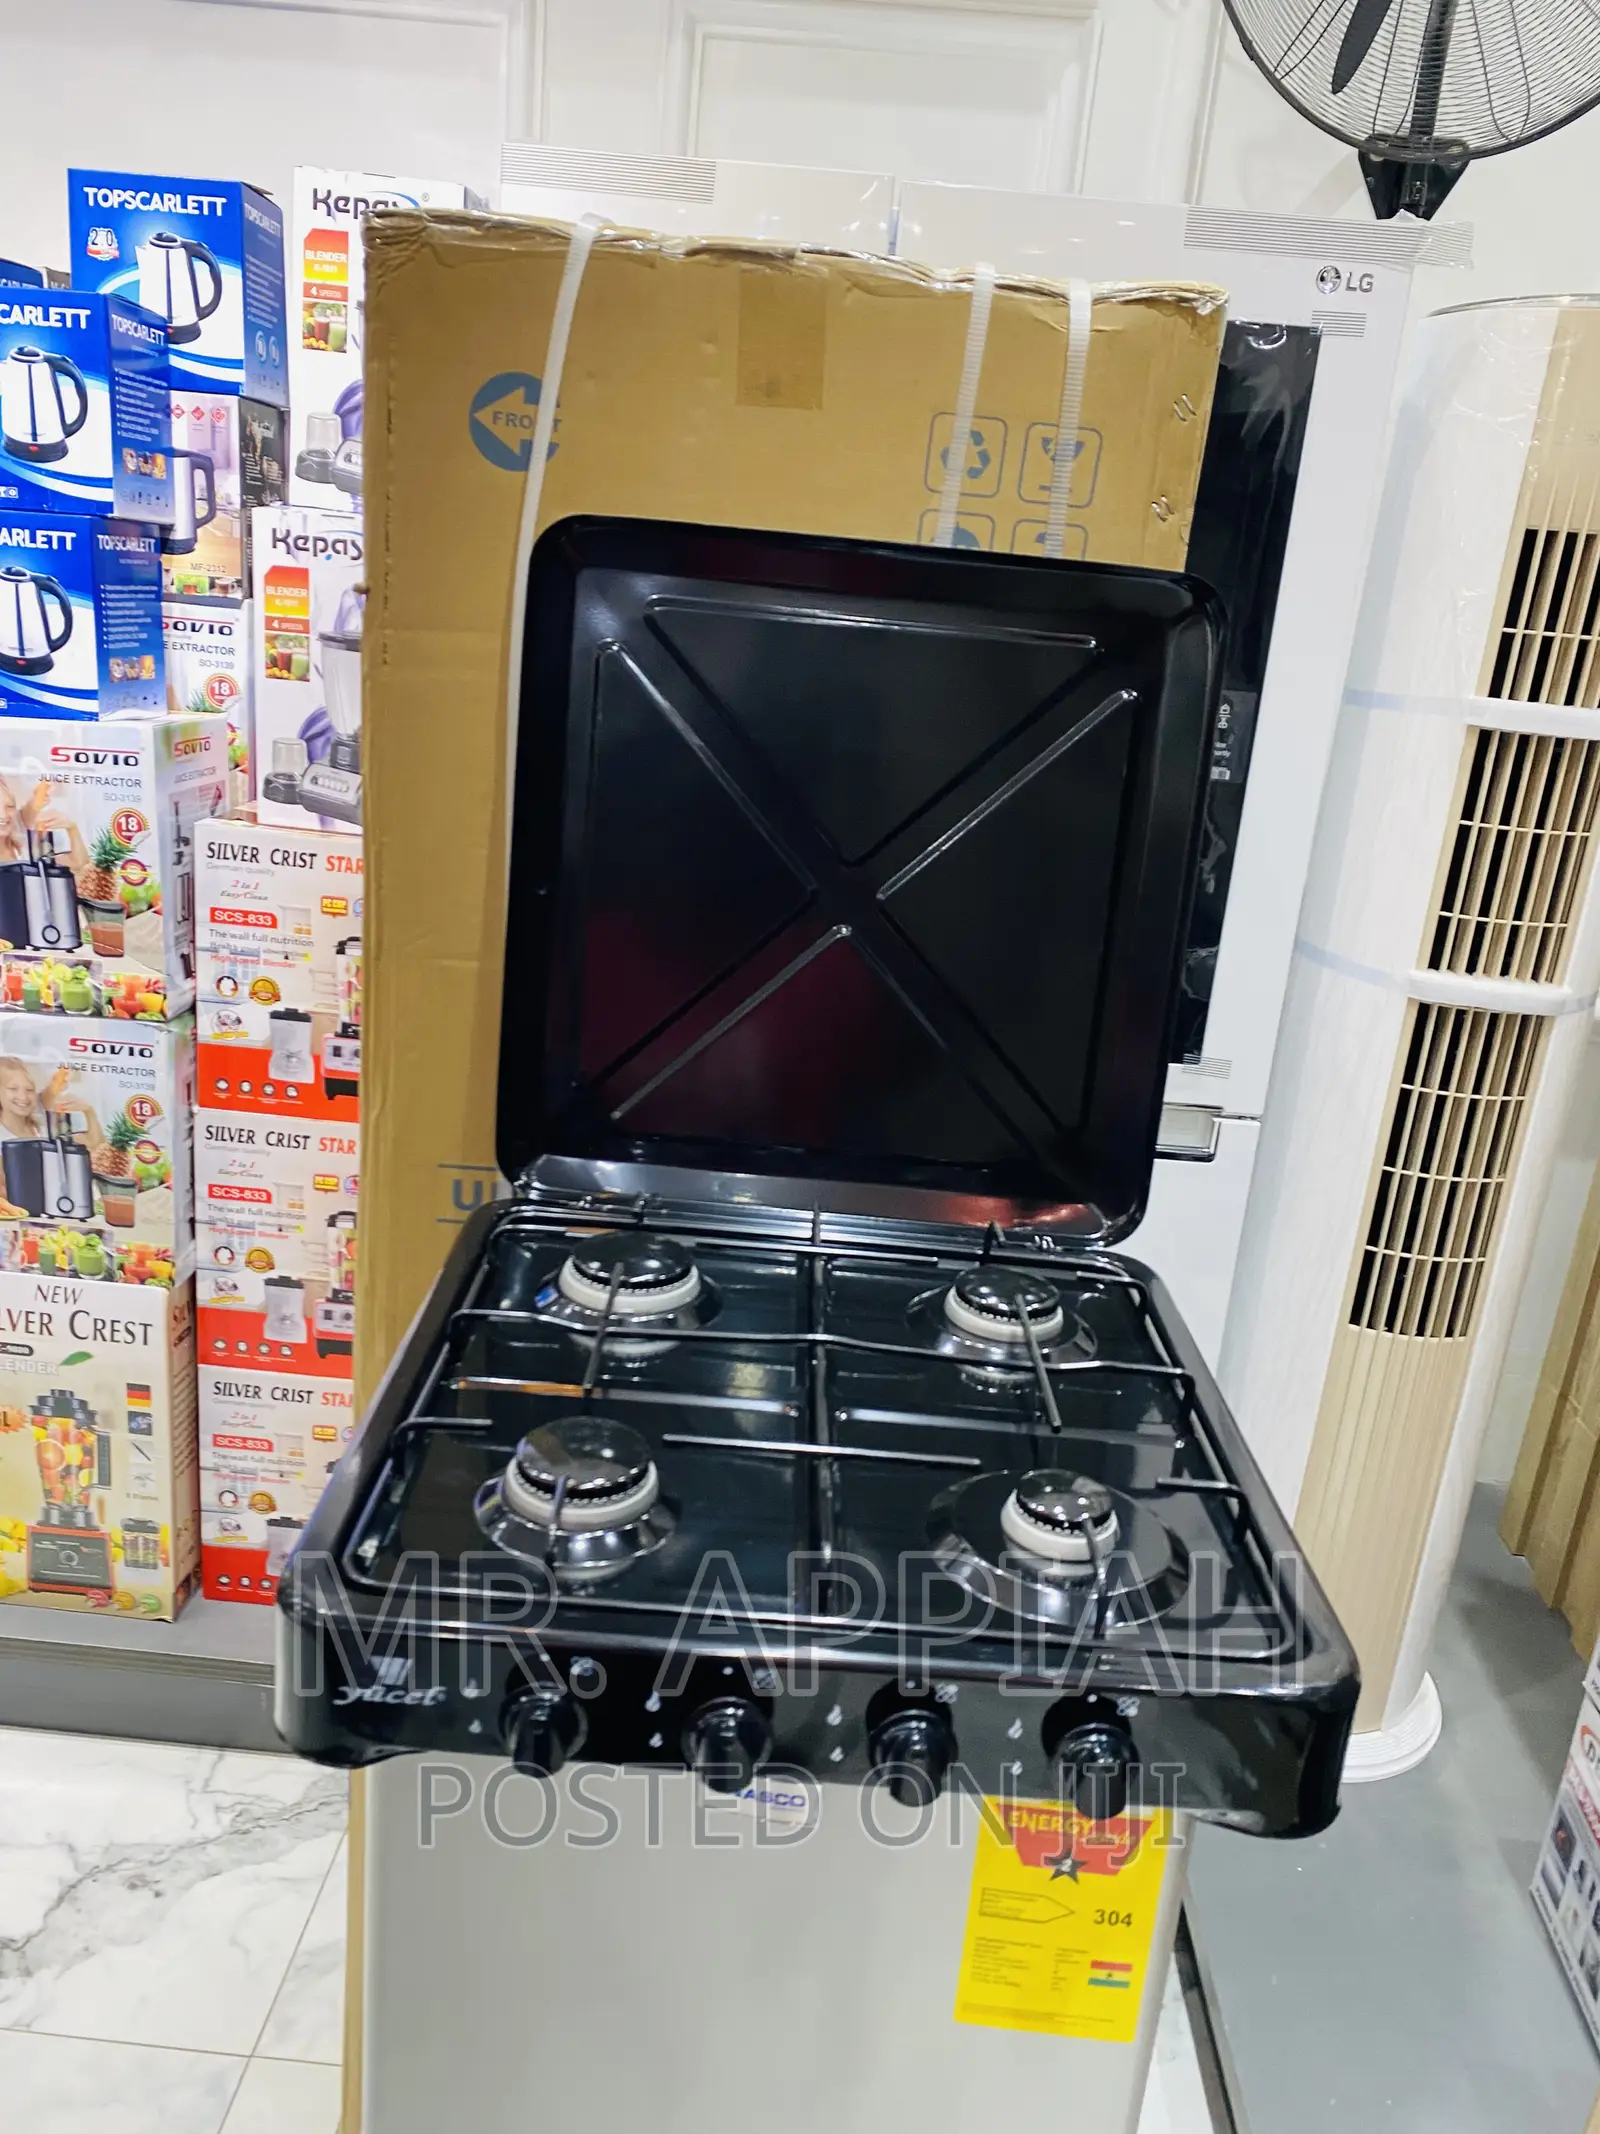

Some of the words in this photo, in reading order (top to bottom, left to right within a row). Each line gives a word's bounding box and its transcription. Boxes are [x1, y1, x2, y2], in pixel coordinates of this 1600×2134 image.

[83, 187, 227, 216] TOPSCARLETT
[304, 249, 348, 263] BLENDER
[1345, 271, 1375, 293] LG
[111, 314, 165, 346] TOPSCARLETT
[492, 411, 562, 433] FROT
[97, 534, 156, 553] TOPSCARLETT
[265, 585, 308, 597] BLENDER
[272, 620, 279, 629] 4
[172, 642, 235, 656] EXTRACTOR
[212, 682, 231, 696] 18
[38, 773, 70, 784] JUICE
[74, 775, 142, 789] EXTRACTOR
[119, 816, 139, 832] 18
[206, 841, 261, 864] SILVER
[270, 848, 317, 870] CRIST
[325, 854, 364, 875] STAR
[214, 910, 272, 926] SCS-833
[209, 929, 227, 939] The
[229, 931, 250, 941] wall
[252, 933, 269, 943] full
[270, 936, 315, 948] nutrition
[57, 1062, 88, 1072] JUICE
[91, 1063, 156, 1078] EXTRACTOR
[133, 1102, 151, 1116] 18
[205, 1124, 256, 1145] SILVER
[265, 1131, 311, 1150] CRIST
[319, 1137, 357, 1155] STAR
[212, 1187, 267, 1201] SCS-833
[34, 1284, 84, 1305] NEW
[213, 1381, 262, 1400] SILVER
[271, 1386, 314, 1404] CRIST
[216, 1437, 269, 1450] SCS-833
[1008, 1809, 1096, 1838] ENERGY
[1061, 1858, 1072, 1872] 2
[1093, 1909, 1133, 1927] 304
